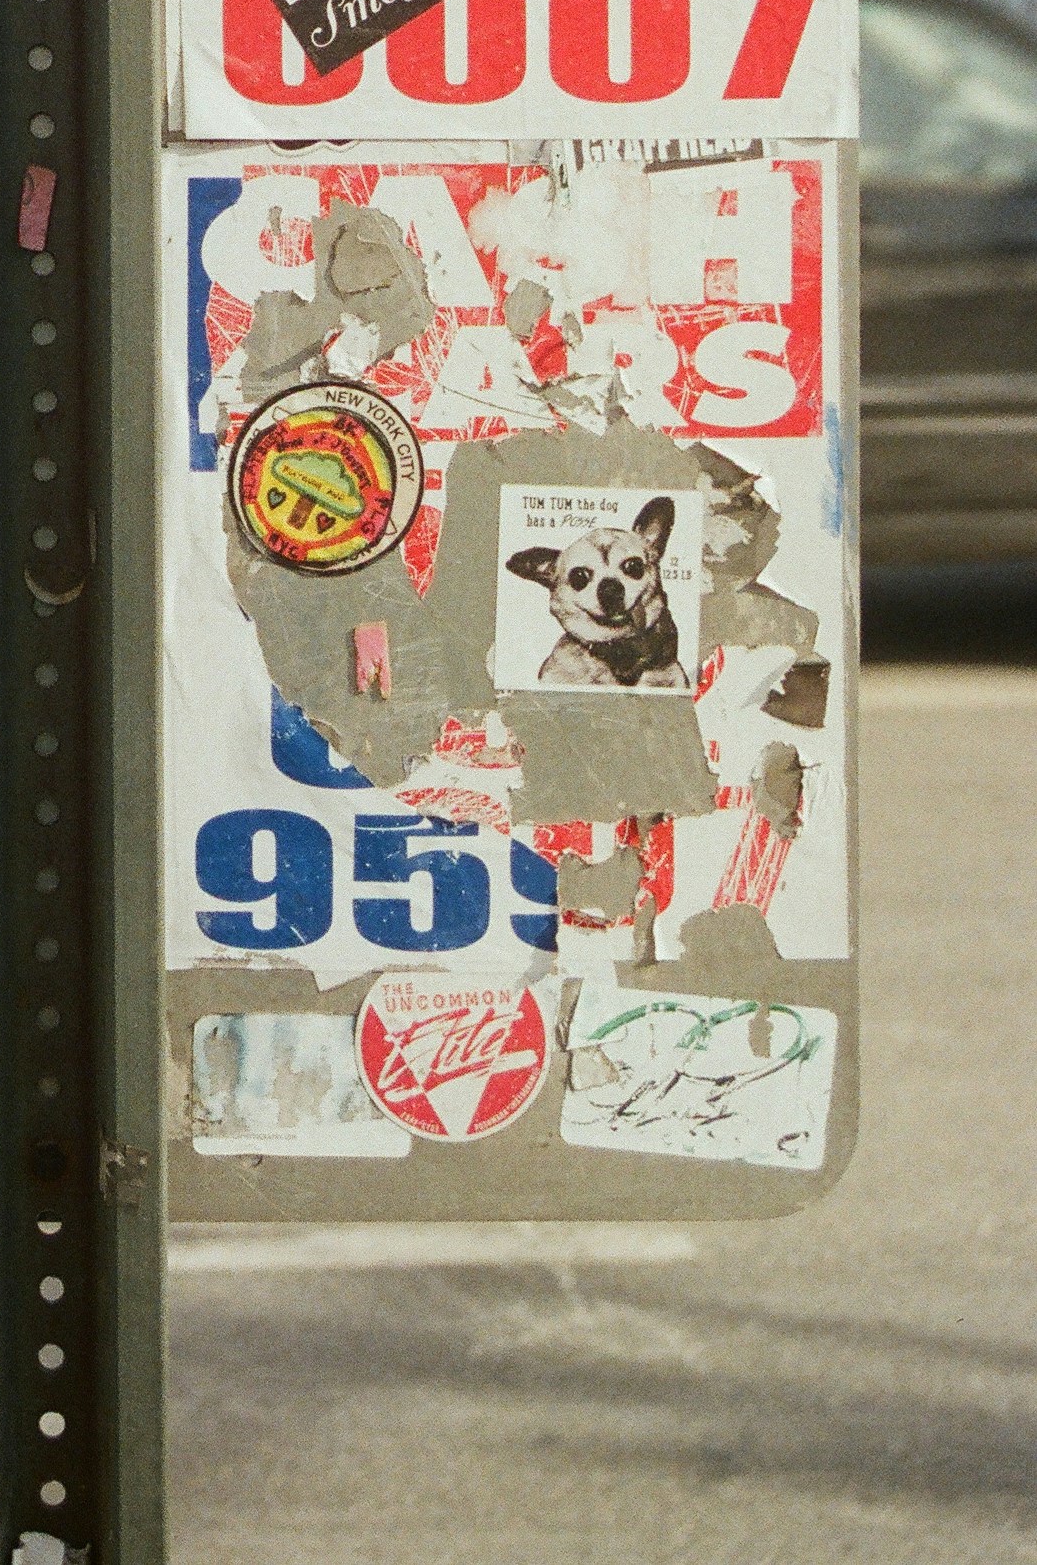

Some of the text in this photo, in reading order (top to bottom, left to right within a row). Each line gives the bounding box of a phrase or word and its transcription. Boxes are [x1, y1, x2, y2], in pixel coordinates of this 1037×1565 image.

[325, 390, 415, 484] NEW YORK CITY
[522, 496, 619, 514] TUM TUM the dog
[526, 514, 545, 528] has
[549, 516, 556, 528] a
[382, 982, 414, 996] THE
[385, 989, 512, 1013] UNCOMMON
